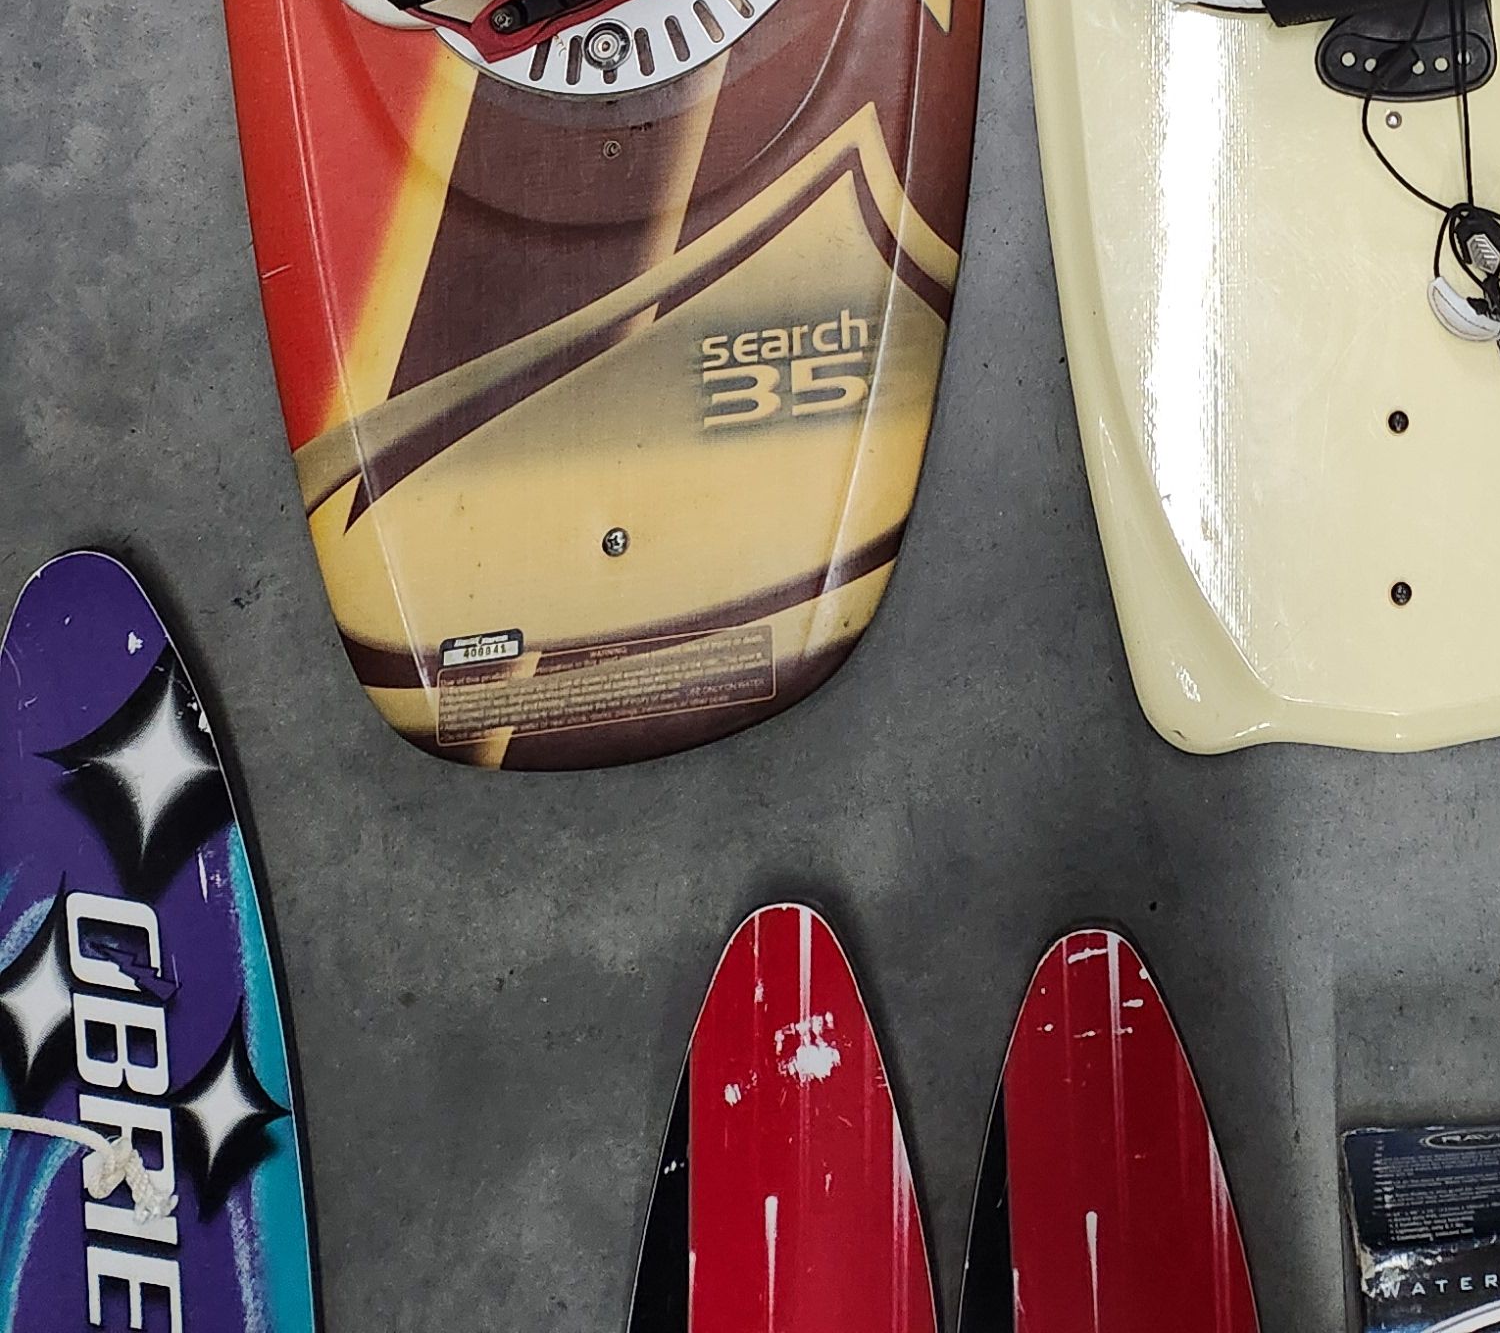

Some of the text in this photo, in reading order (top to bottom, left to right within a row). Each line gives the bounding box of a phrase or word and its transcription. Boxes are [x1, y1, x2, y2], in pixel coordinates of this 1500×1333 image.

[701, 309, 869, 364] search
[701, 353, 869, 431] 35
[1378, 1272, 1499, 1300] WATER
